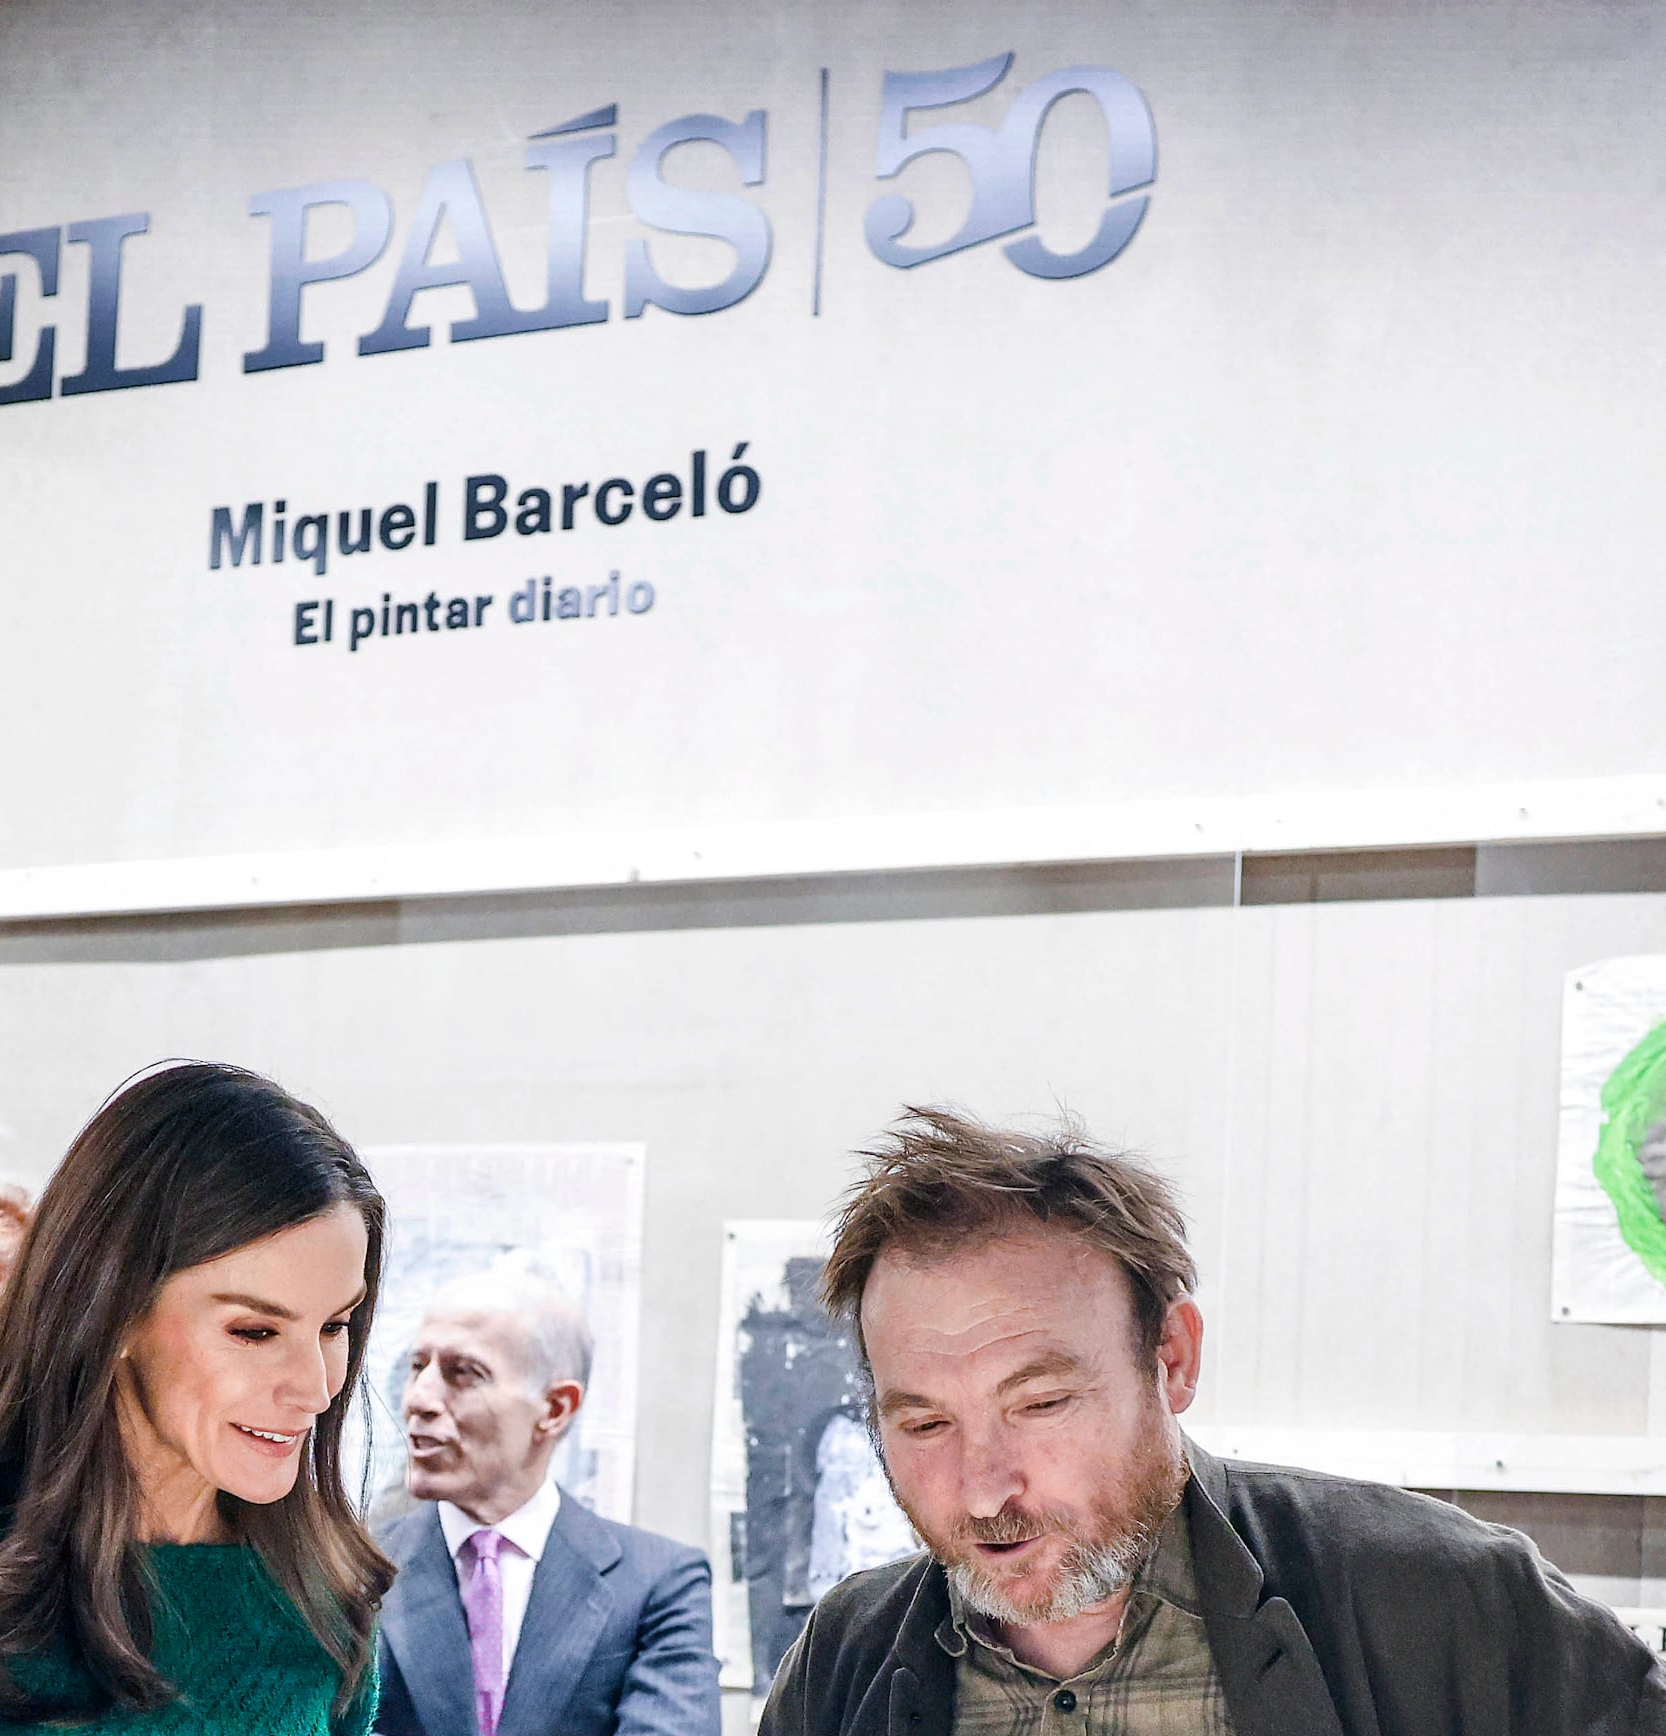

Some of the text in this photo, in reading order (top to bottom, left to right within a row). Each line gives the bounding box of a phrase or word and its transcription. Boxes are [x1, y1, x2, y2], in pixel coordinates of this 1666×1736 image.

[242, 102, 774, 374] PAÍS
[865, 51, 1158, 279] 50
[208, 442, 763, 576] Miquel Barceló
[294, 572, 657, 652] El pintar diario
